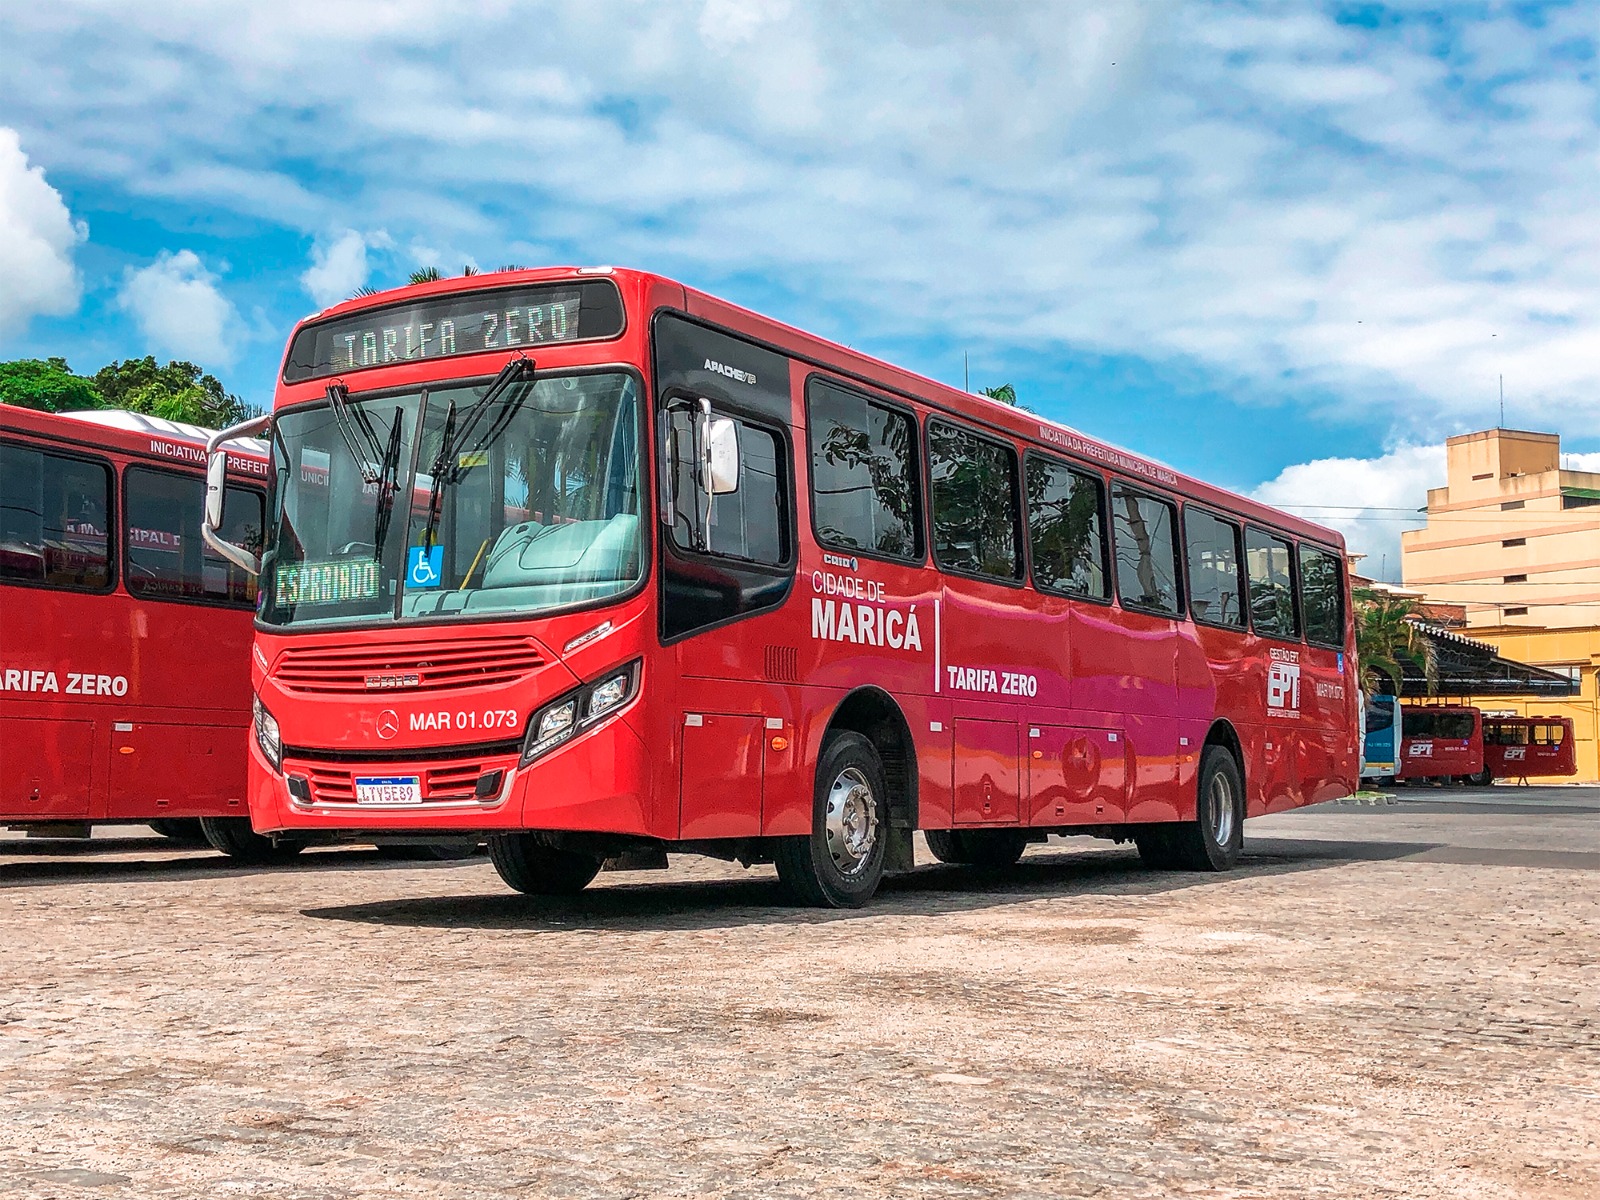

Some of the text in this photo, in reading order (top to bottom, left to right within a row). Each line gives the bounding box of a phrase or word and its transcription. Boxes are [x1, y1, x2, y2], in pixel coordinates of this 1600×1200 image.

[344, 303, 566, 367] TARIFA ZERO
[150, 440, 207, 463] INICIATIVA
[1038, 425, 1073, 449] INICIATIVA
[1072, 438, 1083, 452] DA
[1082, 441, 1120, 465] PREFEITURA
[1119, 455, 1149, 476] MUNICIPAL
[812, 570, 886, 604] CIDADE DE
[811, 598, 922, 652] MARICÁ
[65, 673, 128, 697] ZERO
[947, 665, 1037, 698] TARIFA ZERO
[1267, 661, 1301, 709] EPT
[409, 709, 518, 731] MAR 01.073
[1408, 743, 1433, 755] EPT
[1503, 749, 1526, 759] EPT
